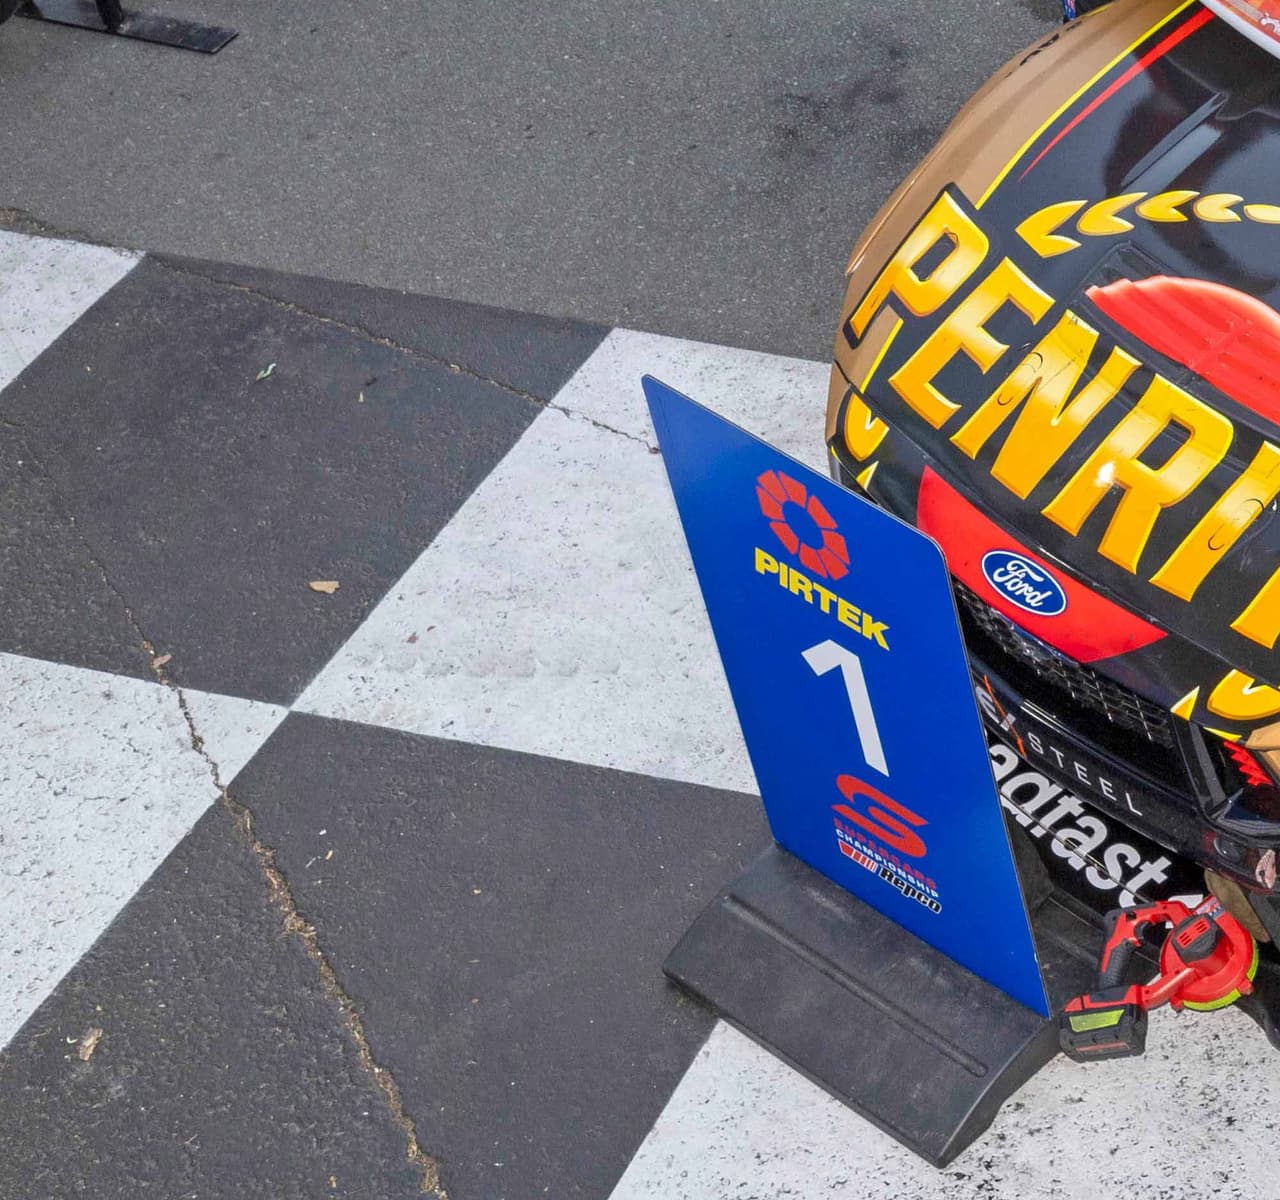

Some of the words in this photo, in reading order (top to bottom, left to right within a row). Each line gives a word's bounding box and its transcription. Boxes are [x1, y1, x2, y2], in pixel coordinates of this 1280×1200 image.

[754, 547, 891, 652] PIRTEK
[989, 556, 1059, 610] Ford
[800, 639, 890, 778] 1
[1027, 732, 1143, 817] STEEL
[835, 828, 940, 899] CHAMPIONSHIP
[985, 743, 1206, 910] adfast
[878, 865, 943, 914] Repco
